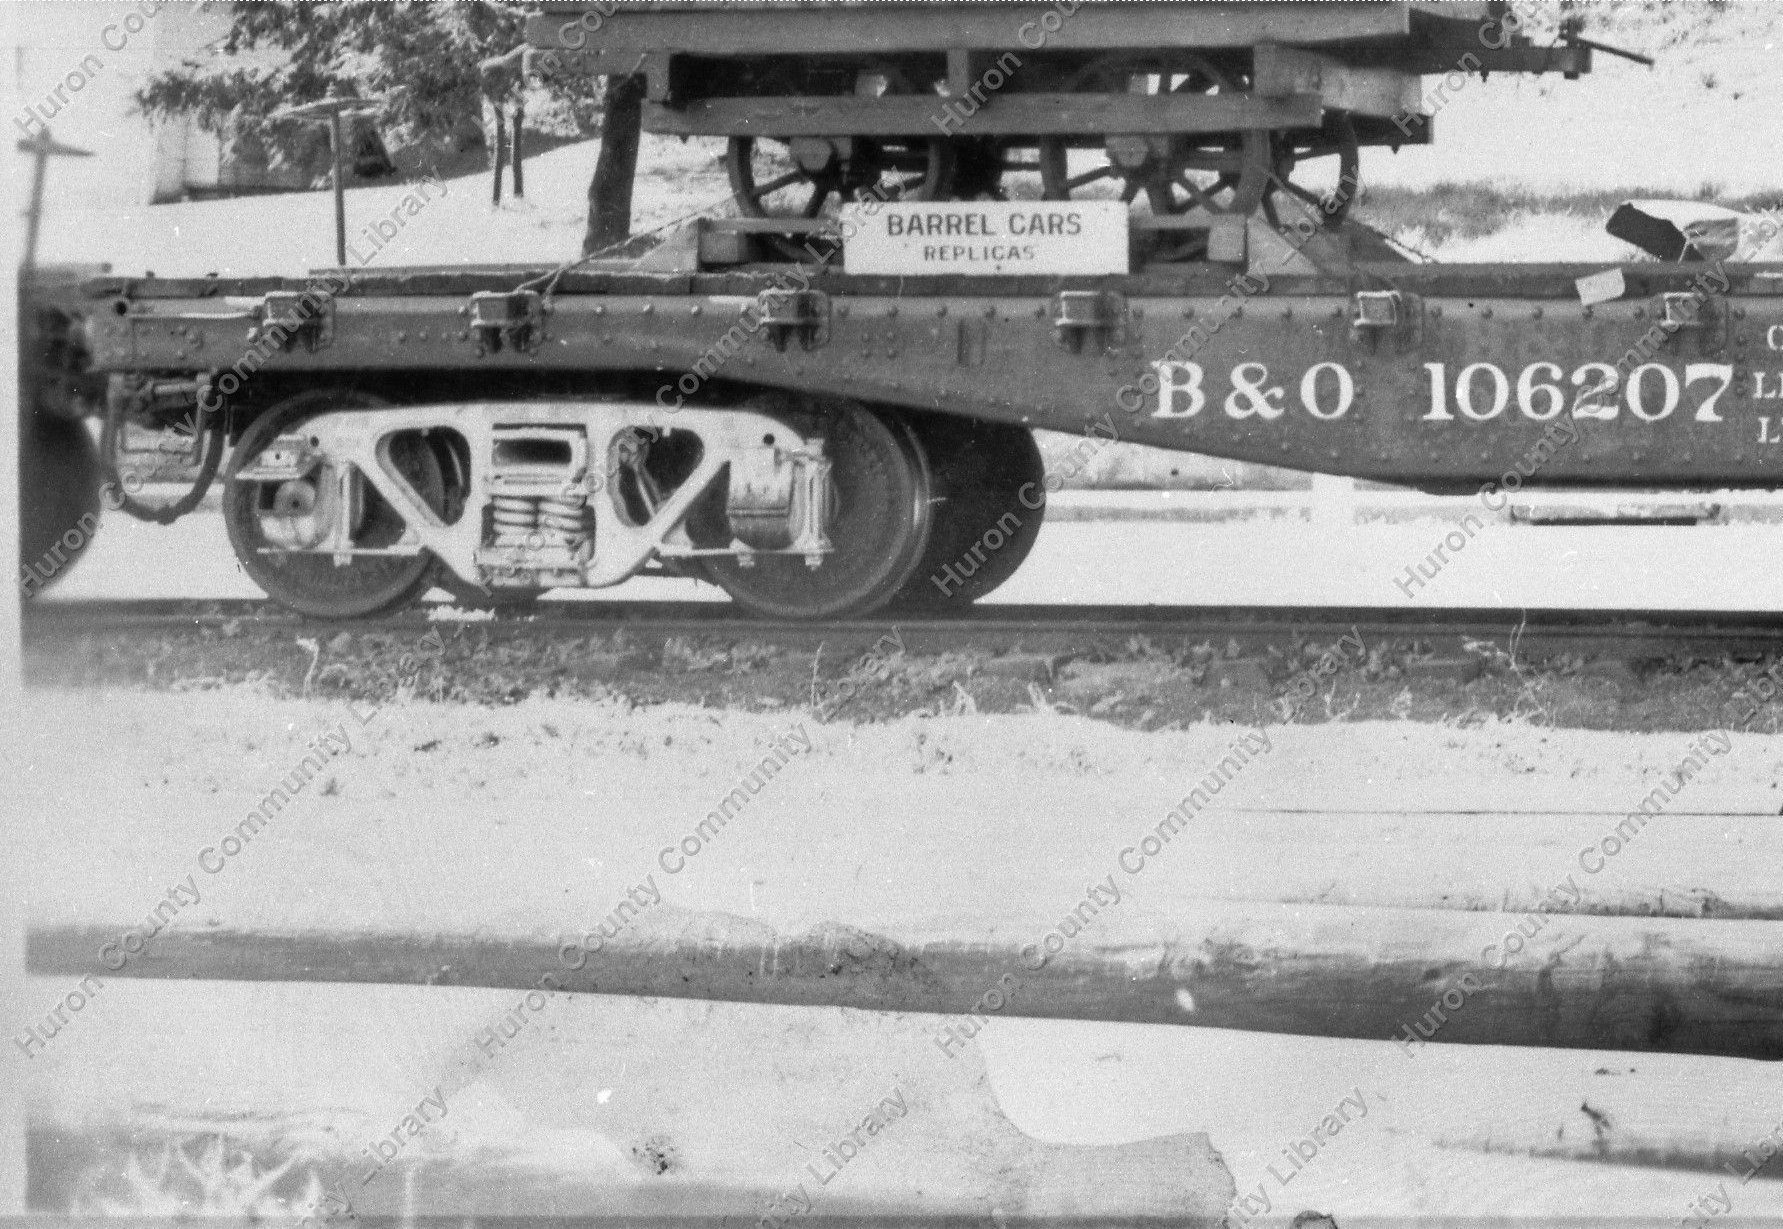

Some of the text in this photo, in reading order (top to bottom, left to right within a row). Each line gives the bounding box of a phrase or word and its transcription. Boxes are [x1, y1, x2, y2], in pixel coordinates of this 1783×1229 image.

[887, 211, 1082, 238] BARREL CARS
[923, 244, 1036, 262] REPLICAS
[1422, 361, 1734, 422] 106207
